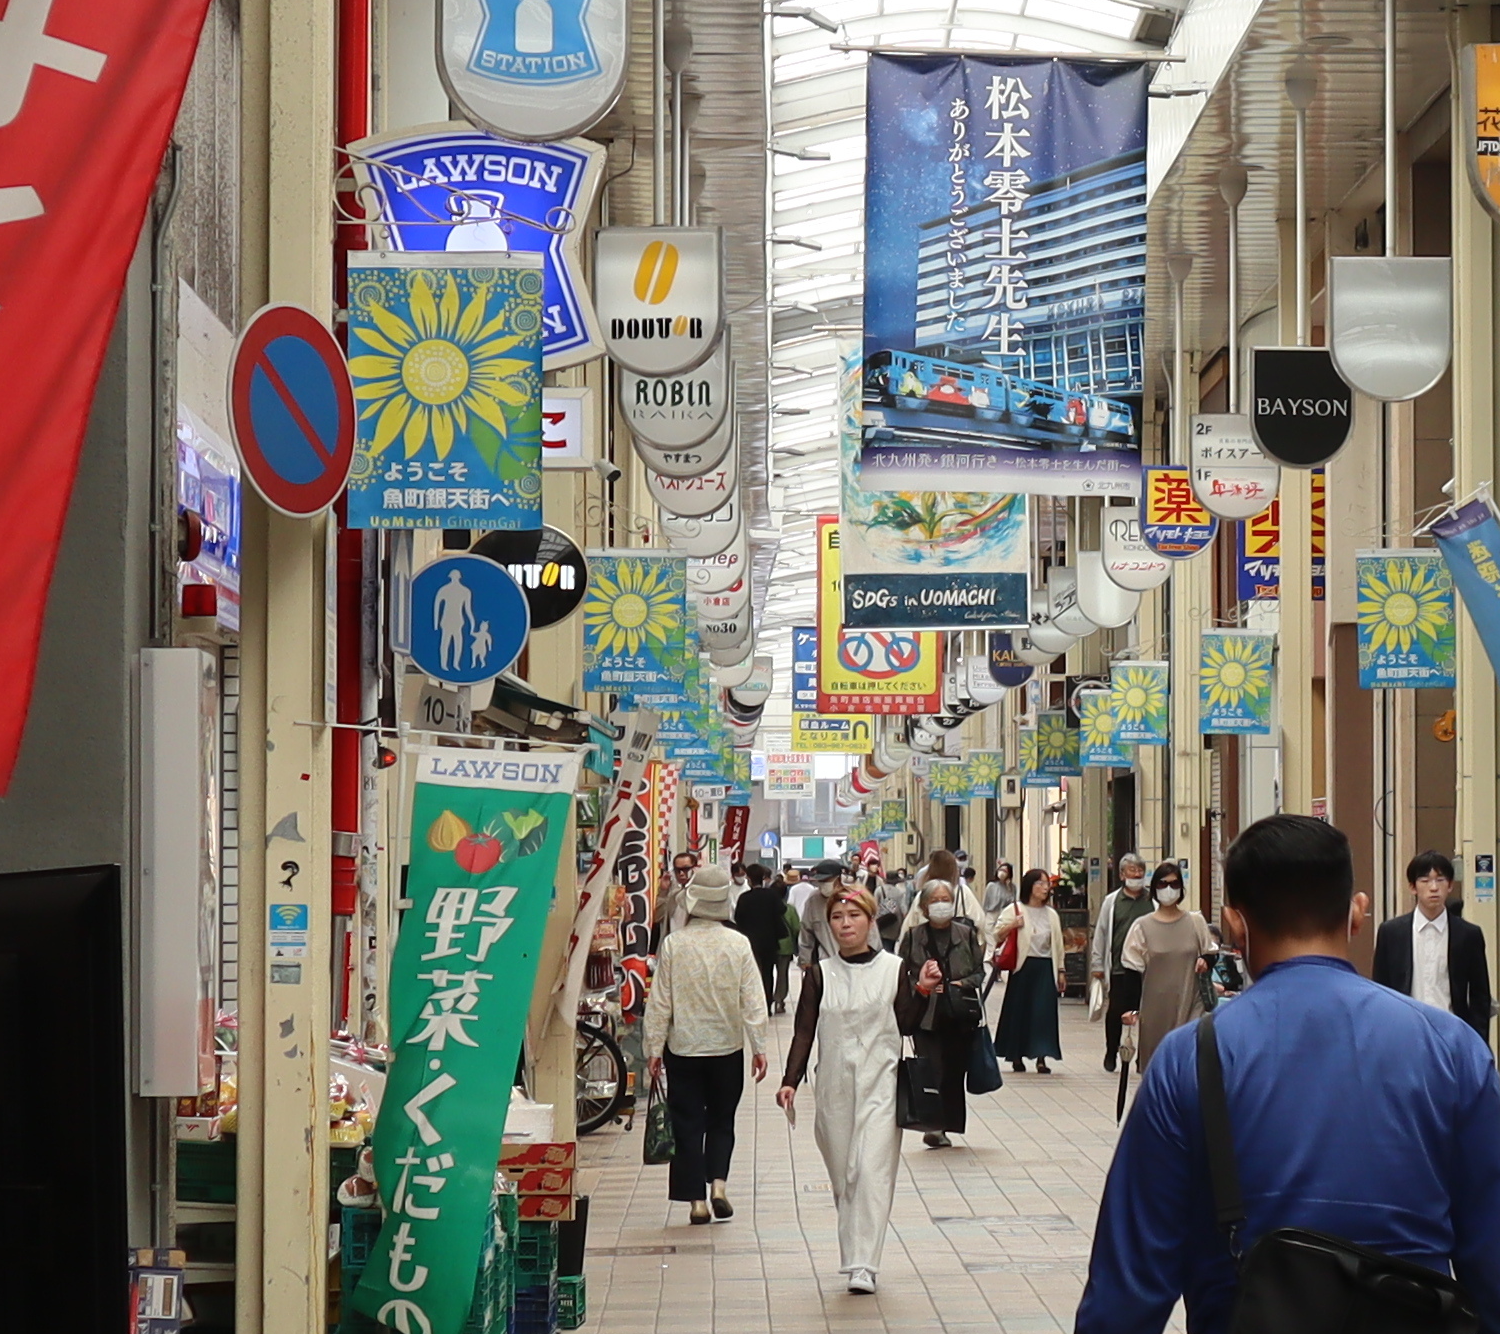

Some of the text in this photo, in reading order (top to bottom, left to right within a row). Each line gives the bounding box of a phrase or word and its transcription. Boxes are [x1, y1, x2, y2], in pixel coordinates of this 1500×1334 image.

[479, 48, 587, 75] STATION
[391, 152, 565, 196] LAWSON
[945, 97, 972, 333] ありがとうございました
[981, 74, 1032, 357] 松本零士先生
[610, 314, 703, 340] DOUTOR
[634, 378, 712, 407] ROBIN
[1256, 398, 1349, 418] BAYSON
[1195, 423, 1213, 436] 2F
[383, 462, 469, 483] ようこそ
[1195, 468, 1212, 481] 1F
[382, 487, 511, 511] 魚町銀天街へ
[1154, 472, 1203, 524] 薬
[369, 514, 441, 529] UoMachi
[851, 587, 997, 611] SDGs in UOMACHI
[601, 656, 647, 668] ようこそ
[1376, 653, 1419, 666] ようこそ
[430, 756, 563, 784] LAWSON
